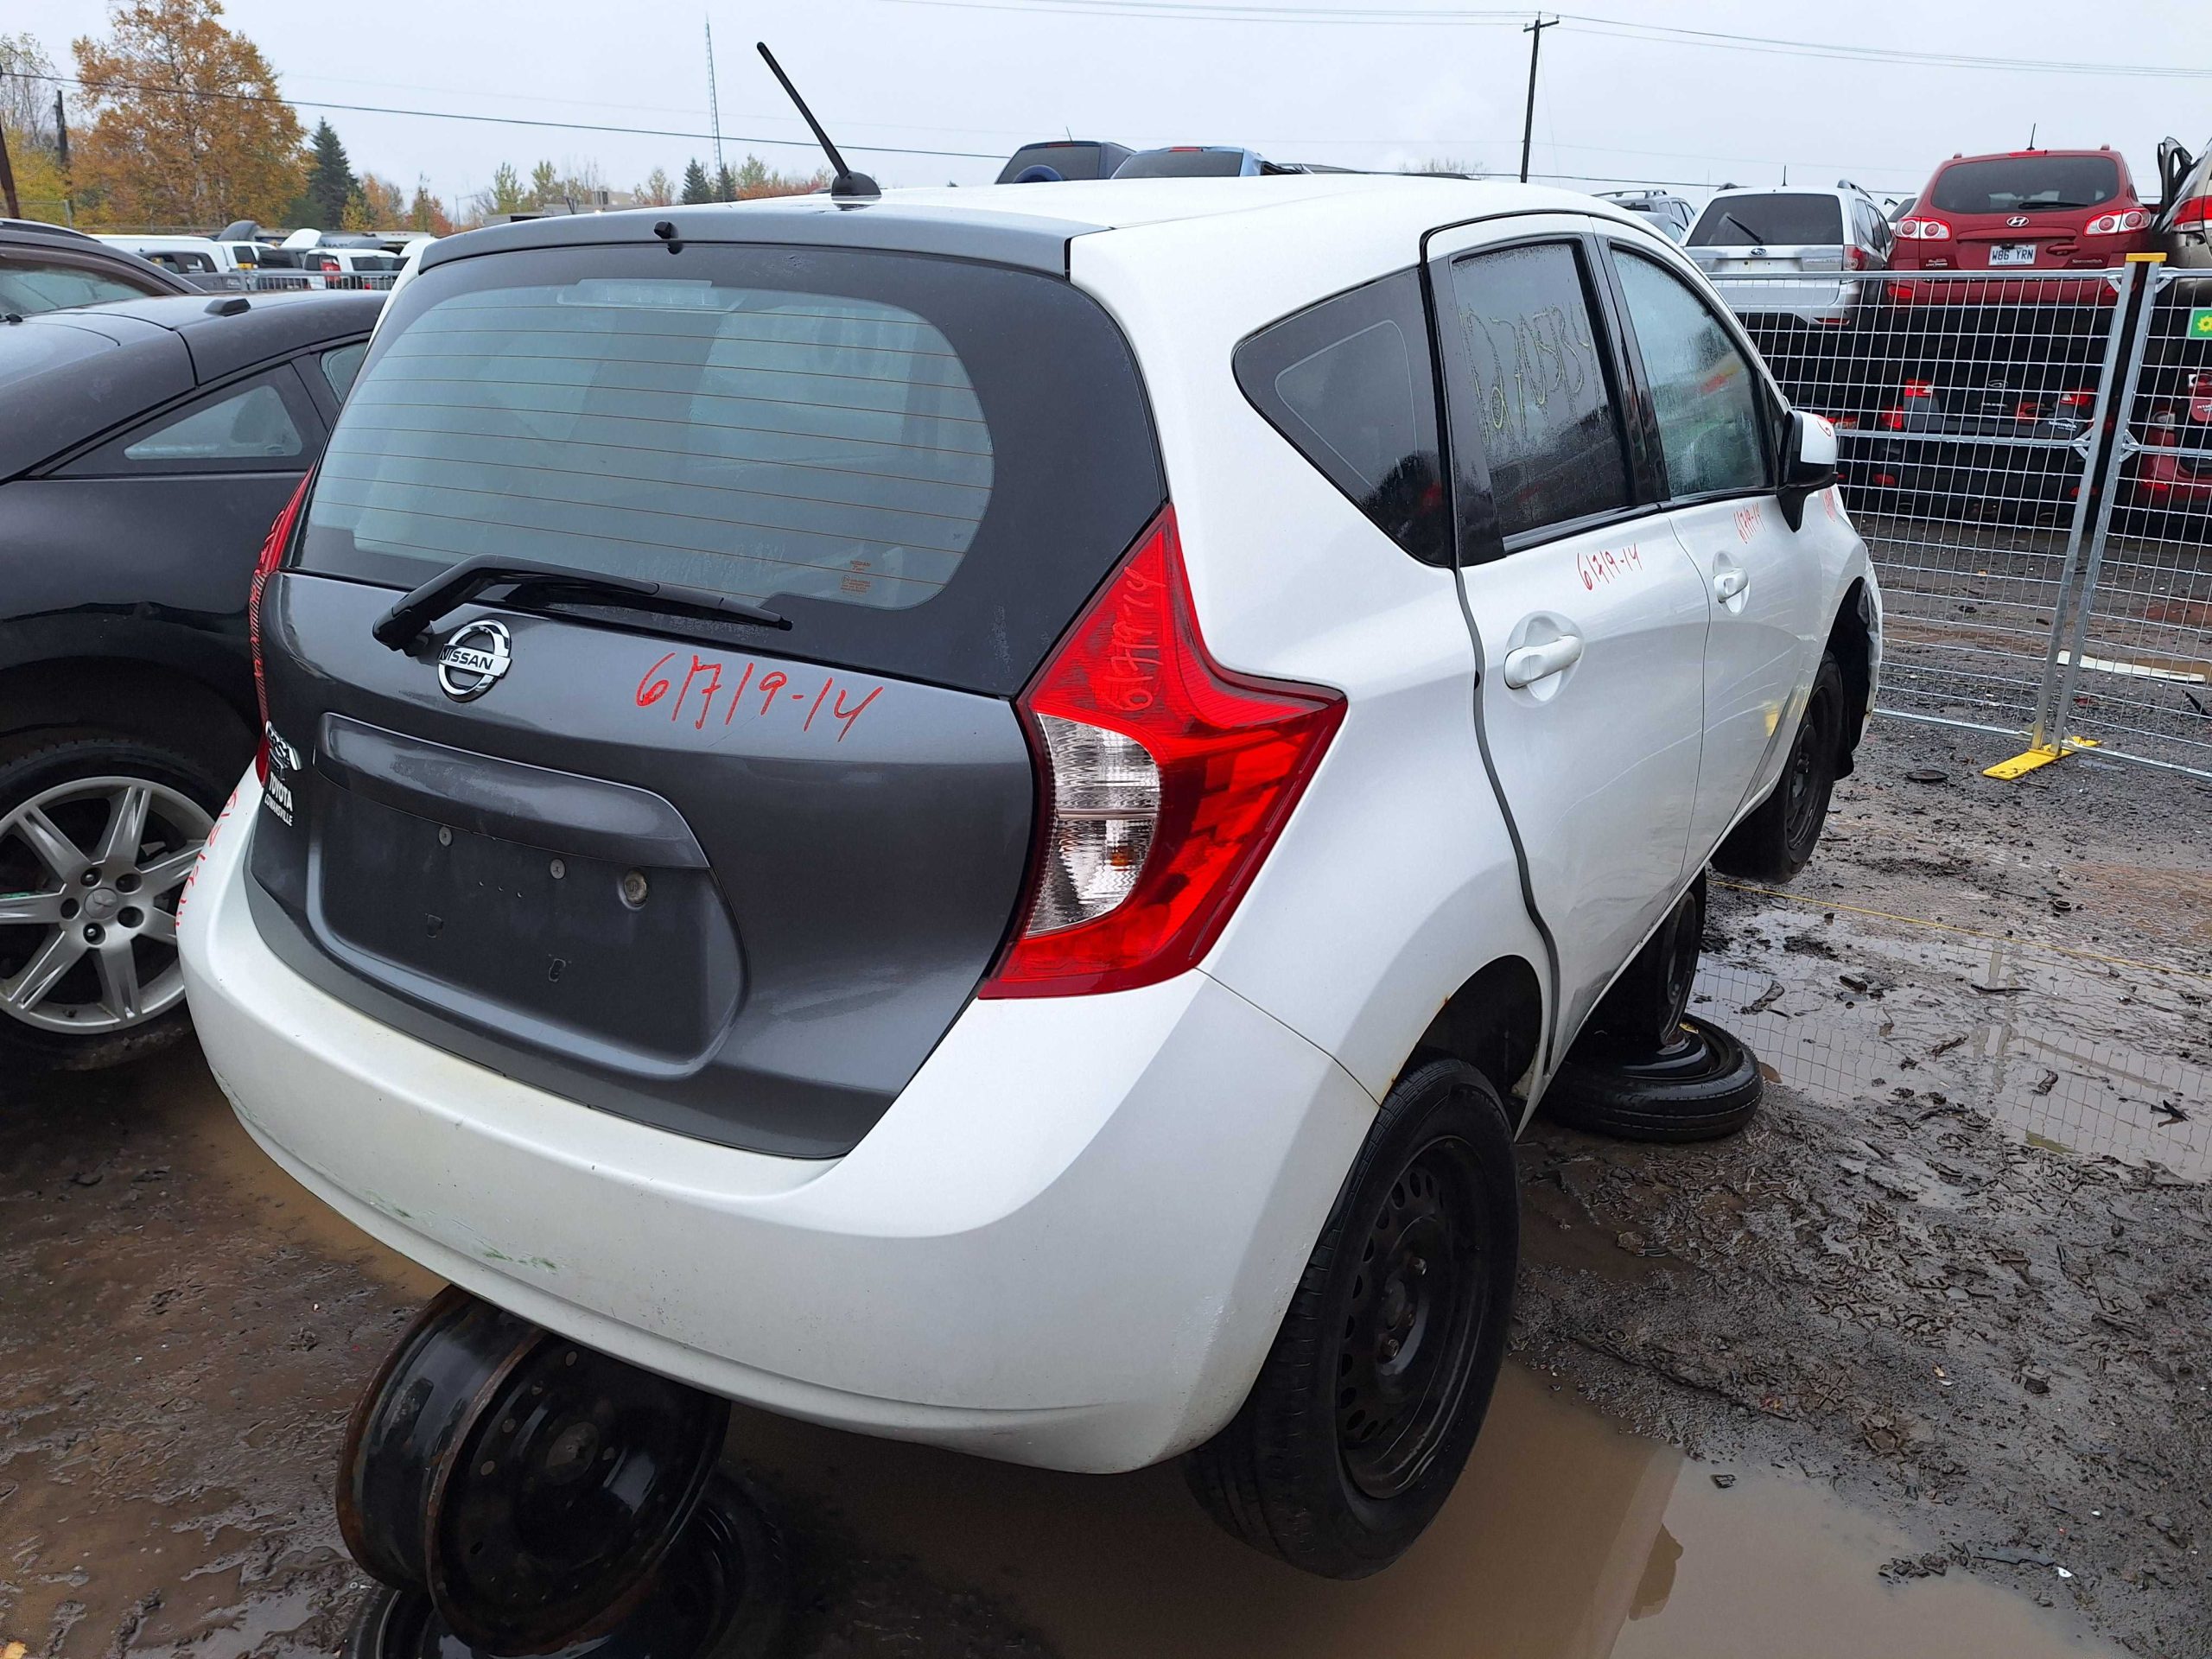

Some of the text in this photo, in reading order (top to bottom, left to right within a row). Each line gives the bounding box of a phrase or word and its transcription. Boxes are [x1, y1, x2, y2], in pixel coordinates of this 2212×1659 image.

[1992, 249, 2034, 261] W86 YRN
[439, 647, 494, 671] NISSAN
[268, 771, 294, 812] TOYOTA
[264, 793, 294, 827] COWANSVILLE
